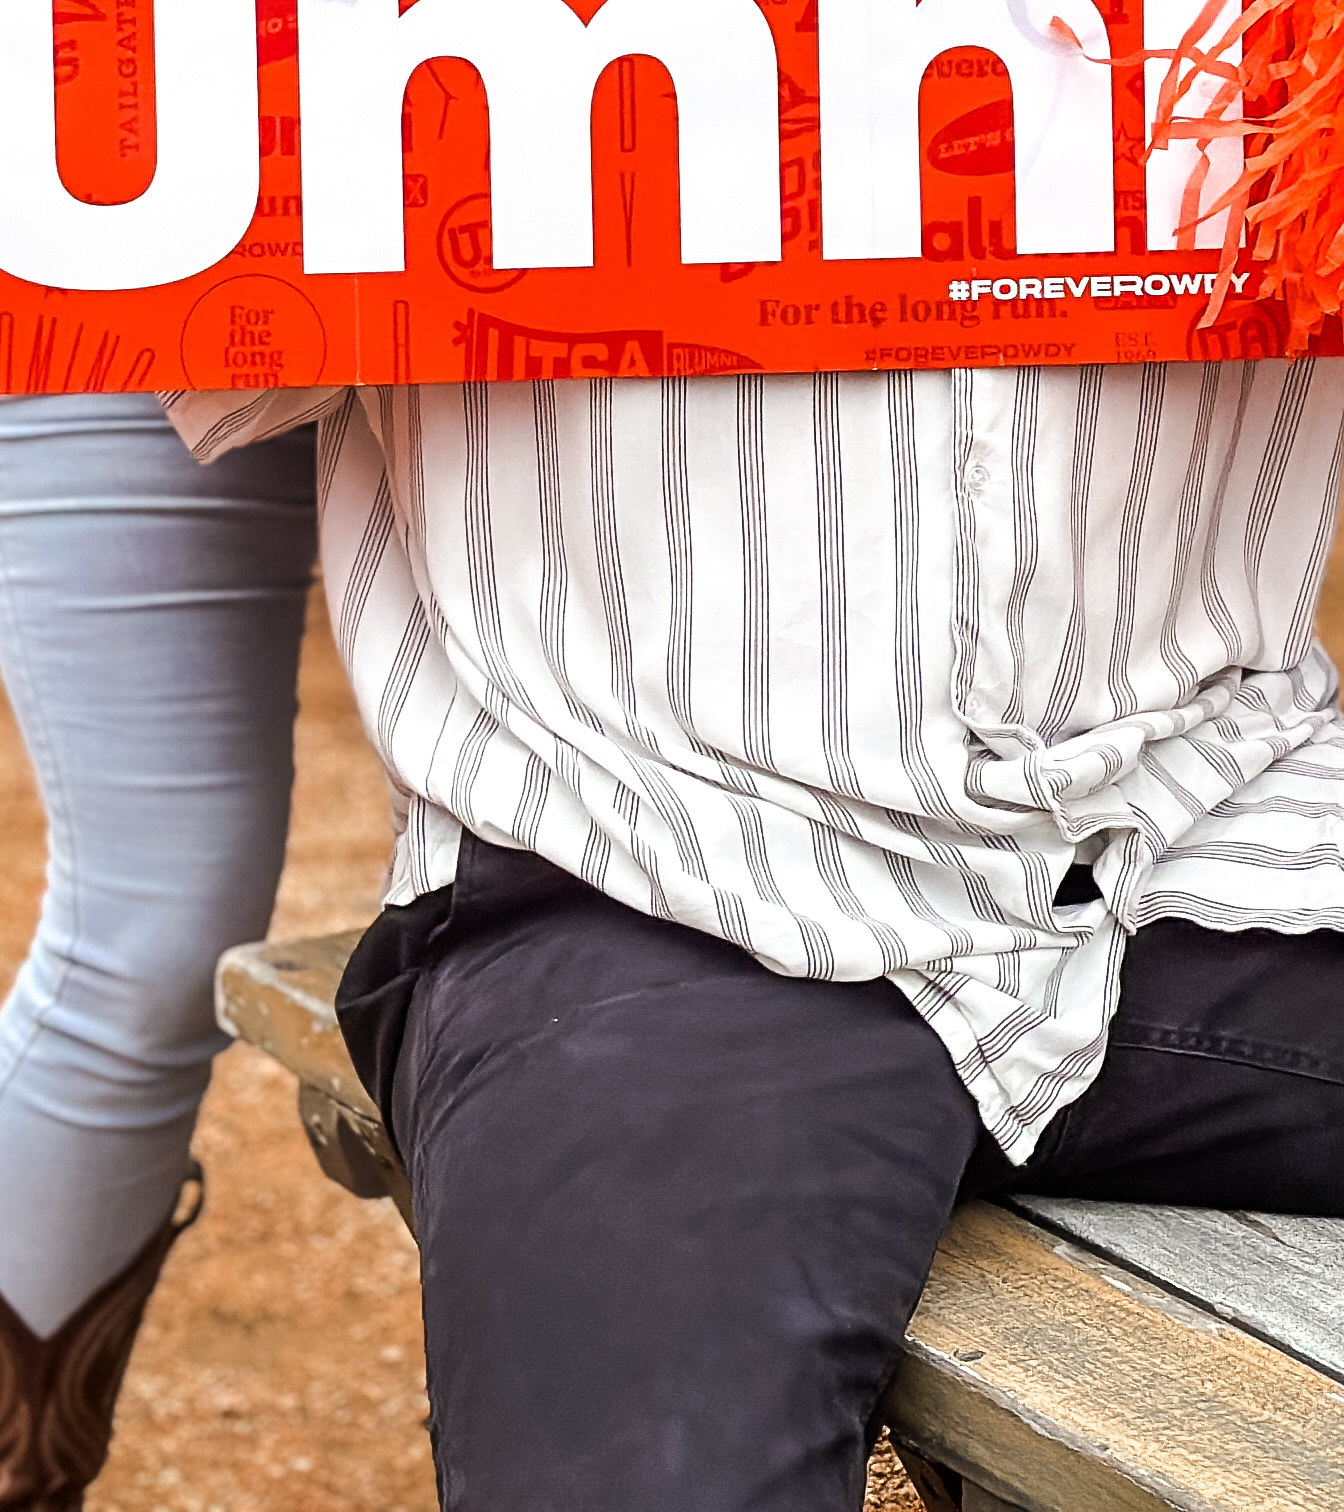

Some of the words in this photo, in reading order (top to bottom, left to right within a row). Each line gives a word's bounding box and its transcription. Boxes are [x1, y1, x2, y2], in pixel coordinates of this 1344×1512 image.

[230, 306, 274, 326] For
[759, 299, 821, 327] For
[832, 296, 888, 327] the
[898, 291, 980, 328] long
[991, 296, 1068, 322] run.
[229, 325, 272, 346] the
[224, 346, 285, 369] long
